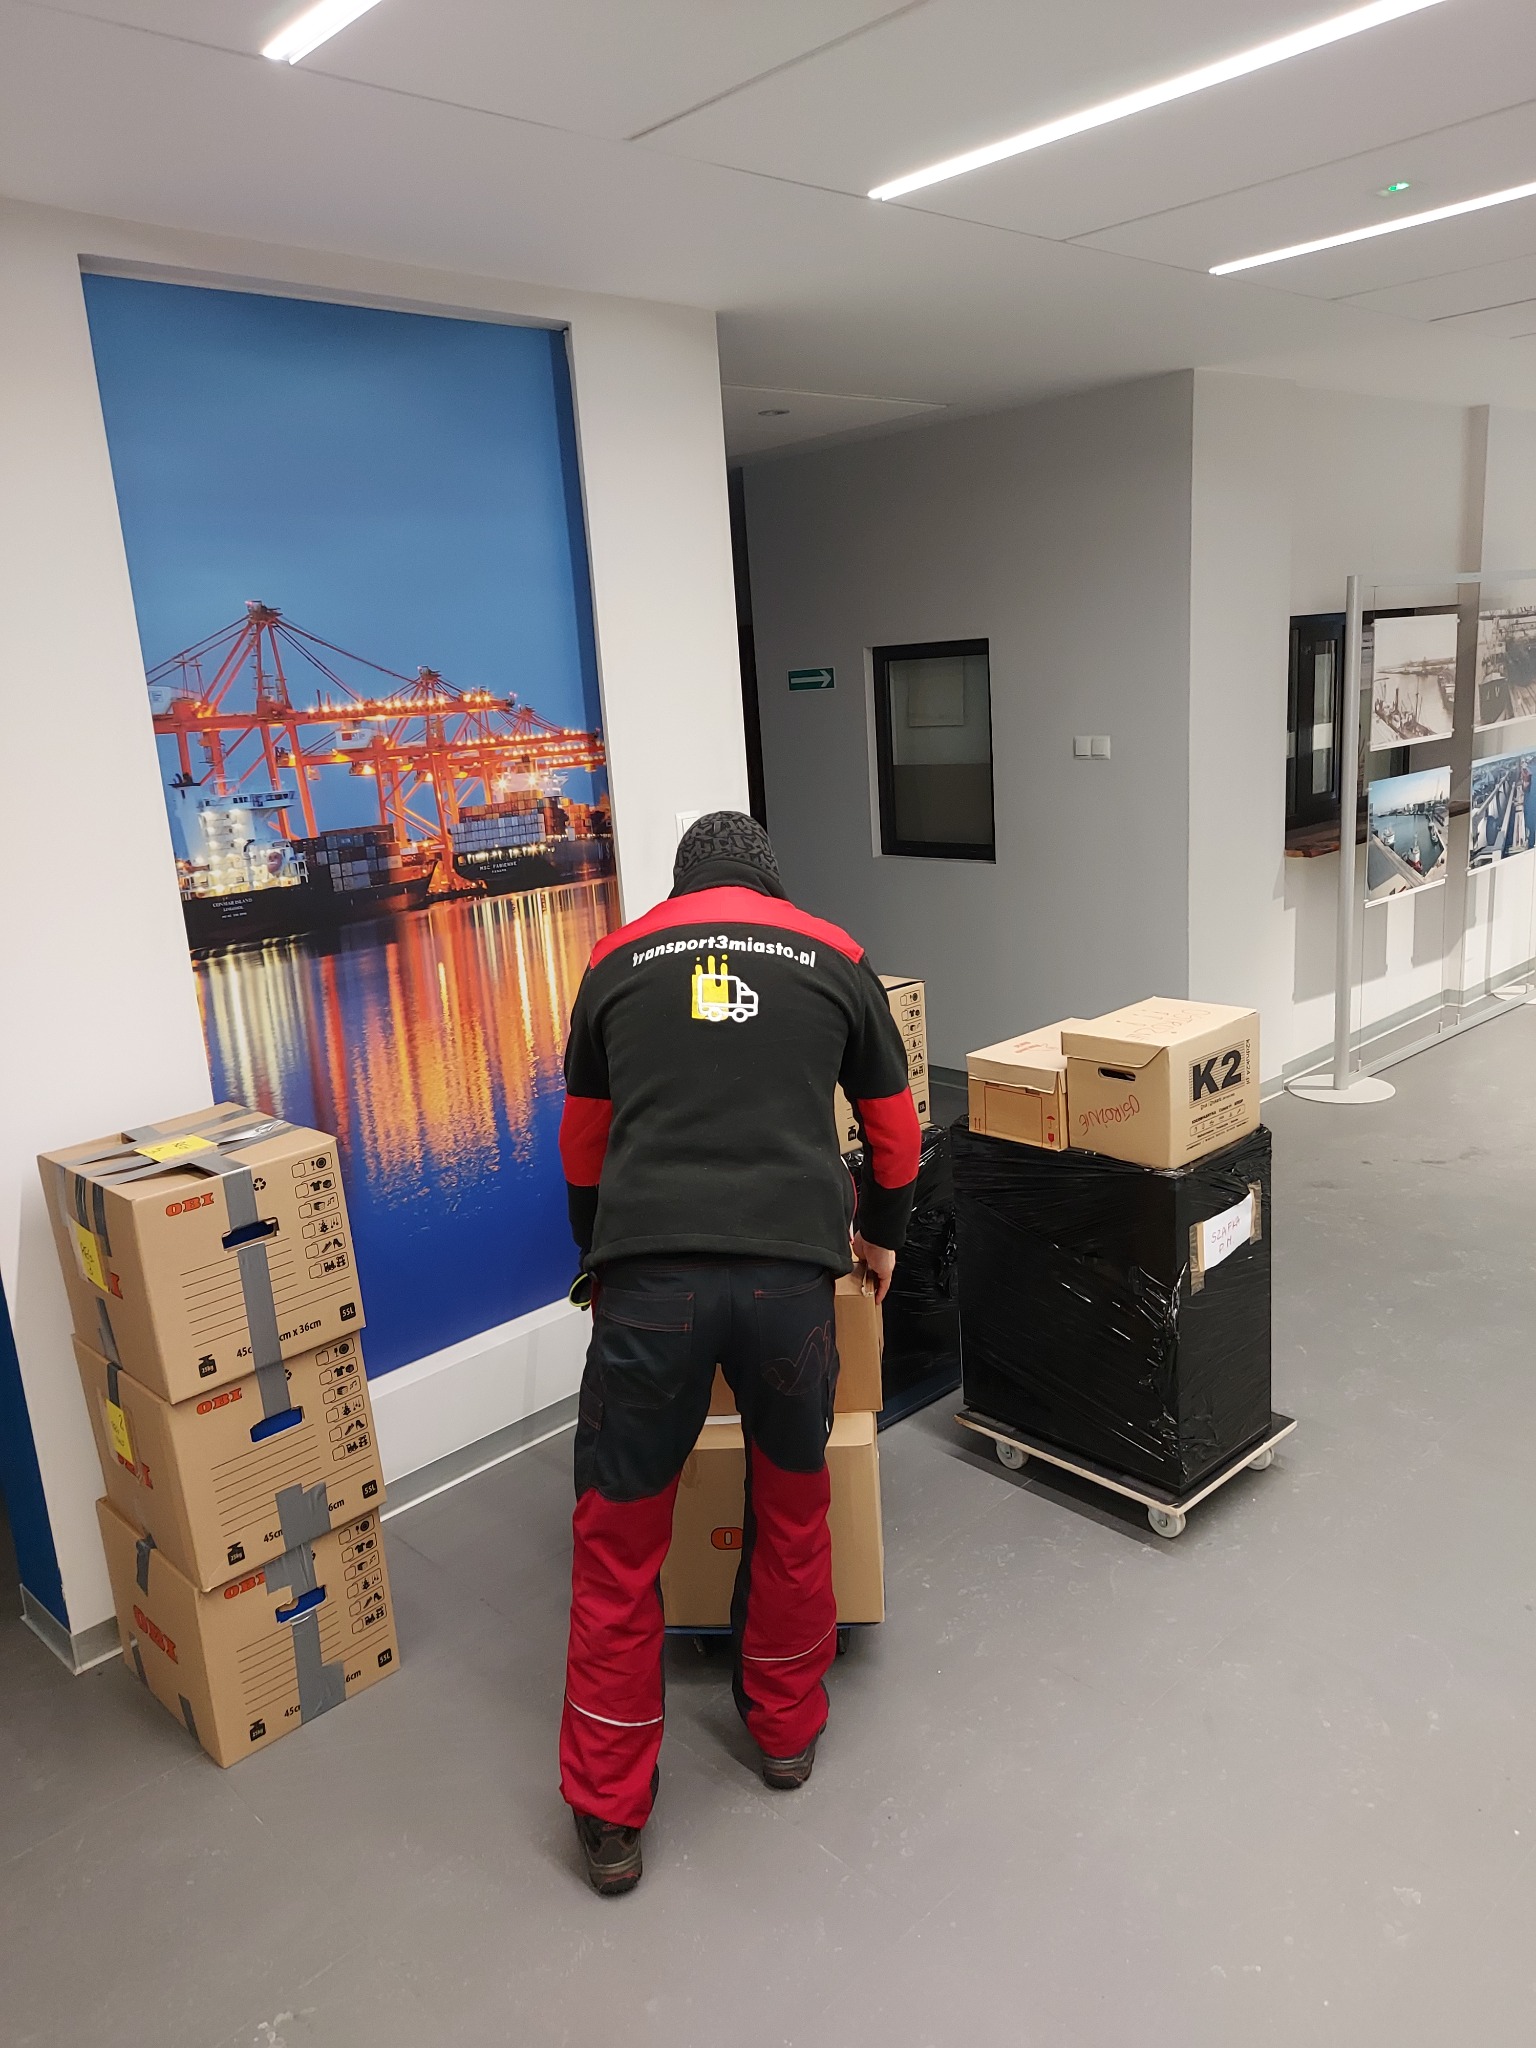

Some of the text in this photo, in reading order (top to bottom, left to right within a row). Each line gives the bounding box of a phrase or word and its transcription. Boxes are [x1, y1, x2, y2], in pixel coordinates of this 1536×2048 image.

[632, 934, 816, 968] transport3miasto.pl
[1192, 1049, 1242, 1102] K2
[165, 1192, 215, 1217] OBI
[342, 1307, 355, 1317] 55L
[236, 1346, 252, 1357] 45c
[292, 1327, 299, 1336] x
[299, 1318, 322, 1334] 36cm
[196, 1387, 243, 1415] OBI
[328, 1498, 345, 1512] 6cm
[133, 1604, 179, 1665] OBI
[345, 1669, 362, 1683] 6cm
